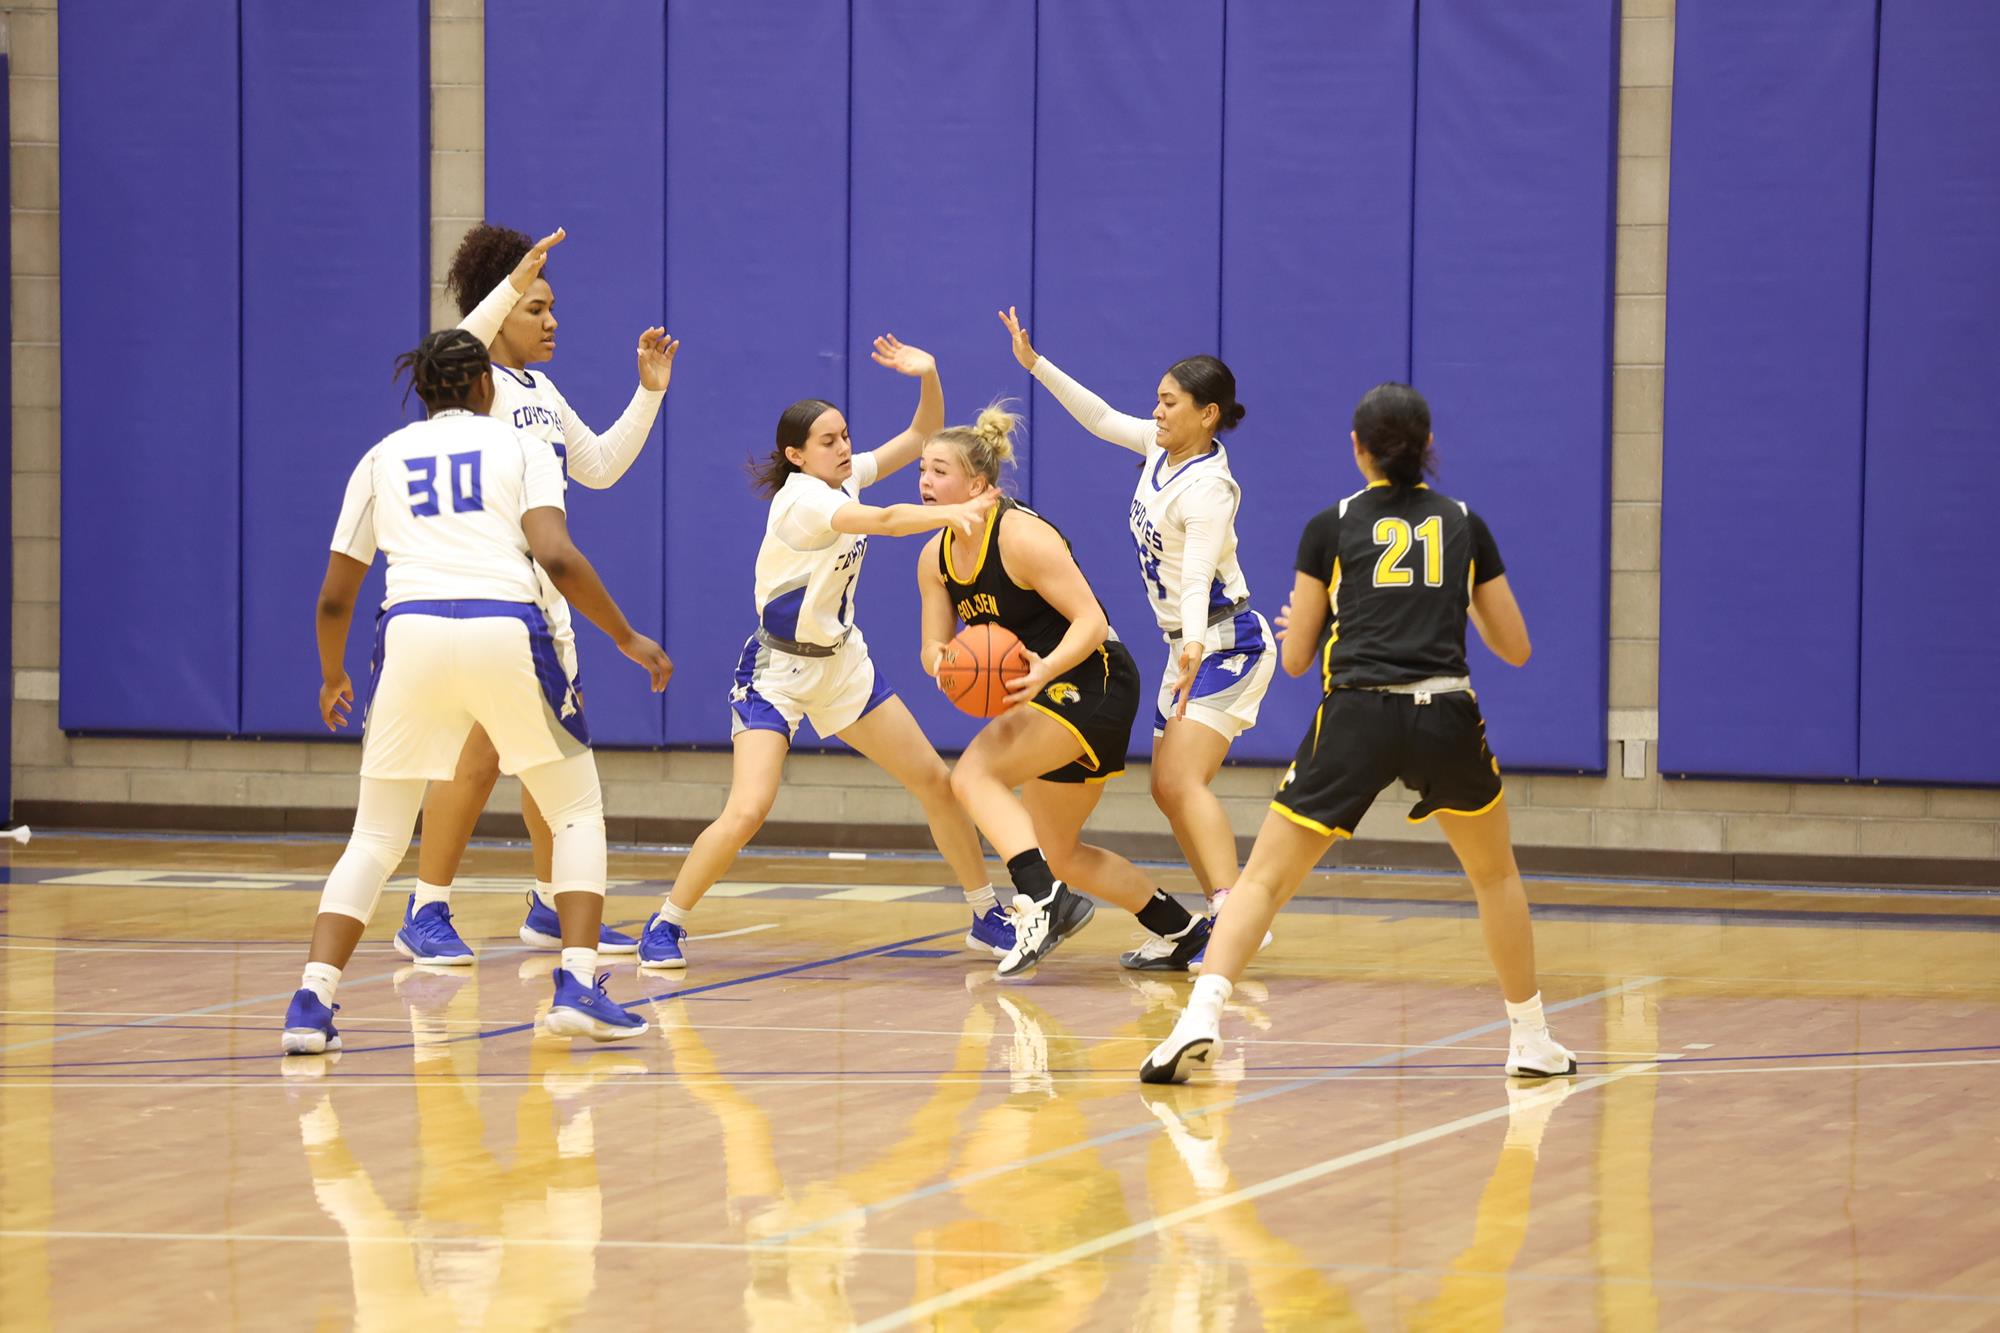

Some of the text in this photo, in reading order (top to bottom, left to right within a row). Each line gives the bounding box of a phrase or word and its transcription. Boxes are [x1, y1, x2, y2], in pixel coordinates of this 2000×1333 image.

[403, 450, 484, 518] 30
[1373, 516, 1443, 587] 21
[957, 593, 1000, 622] GOLDEN
